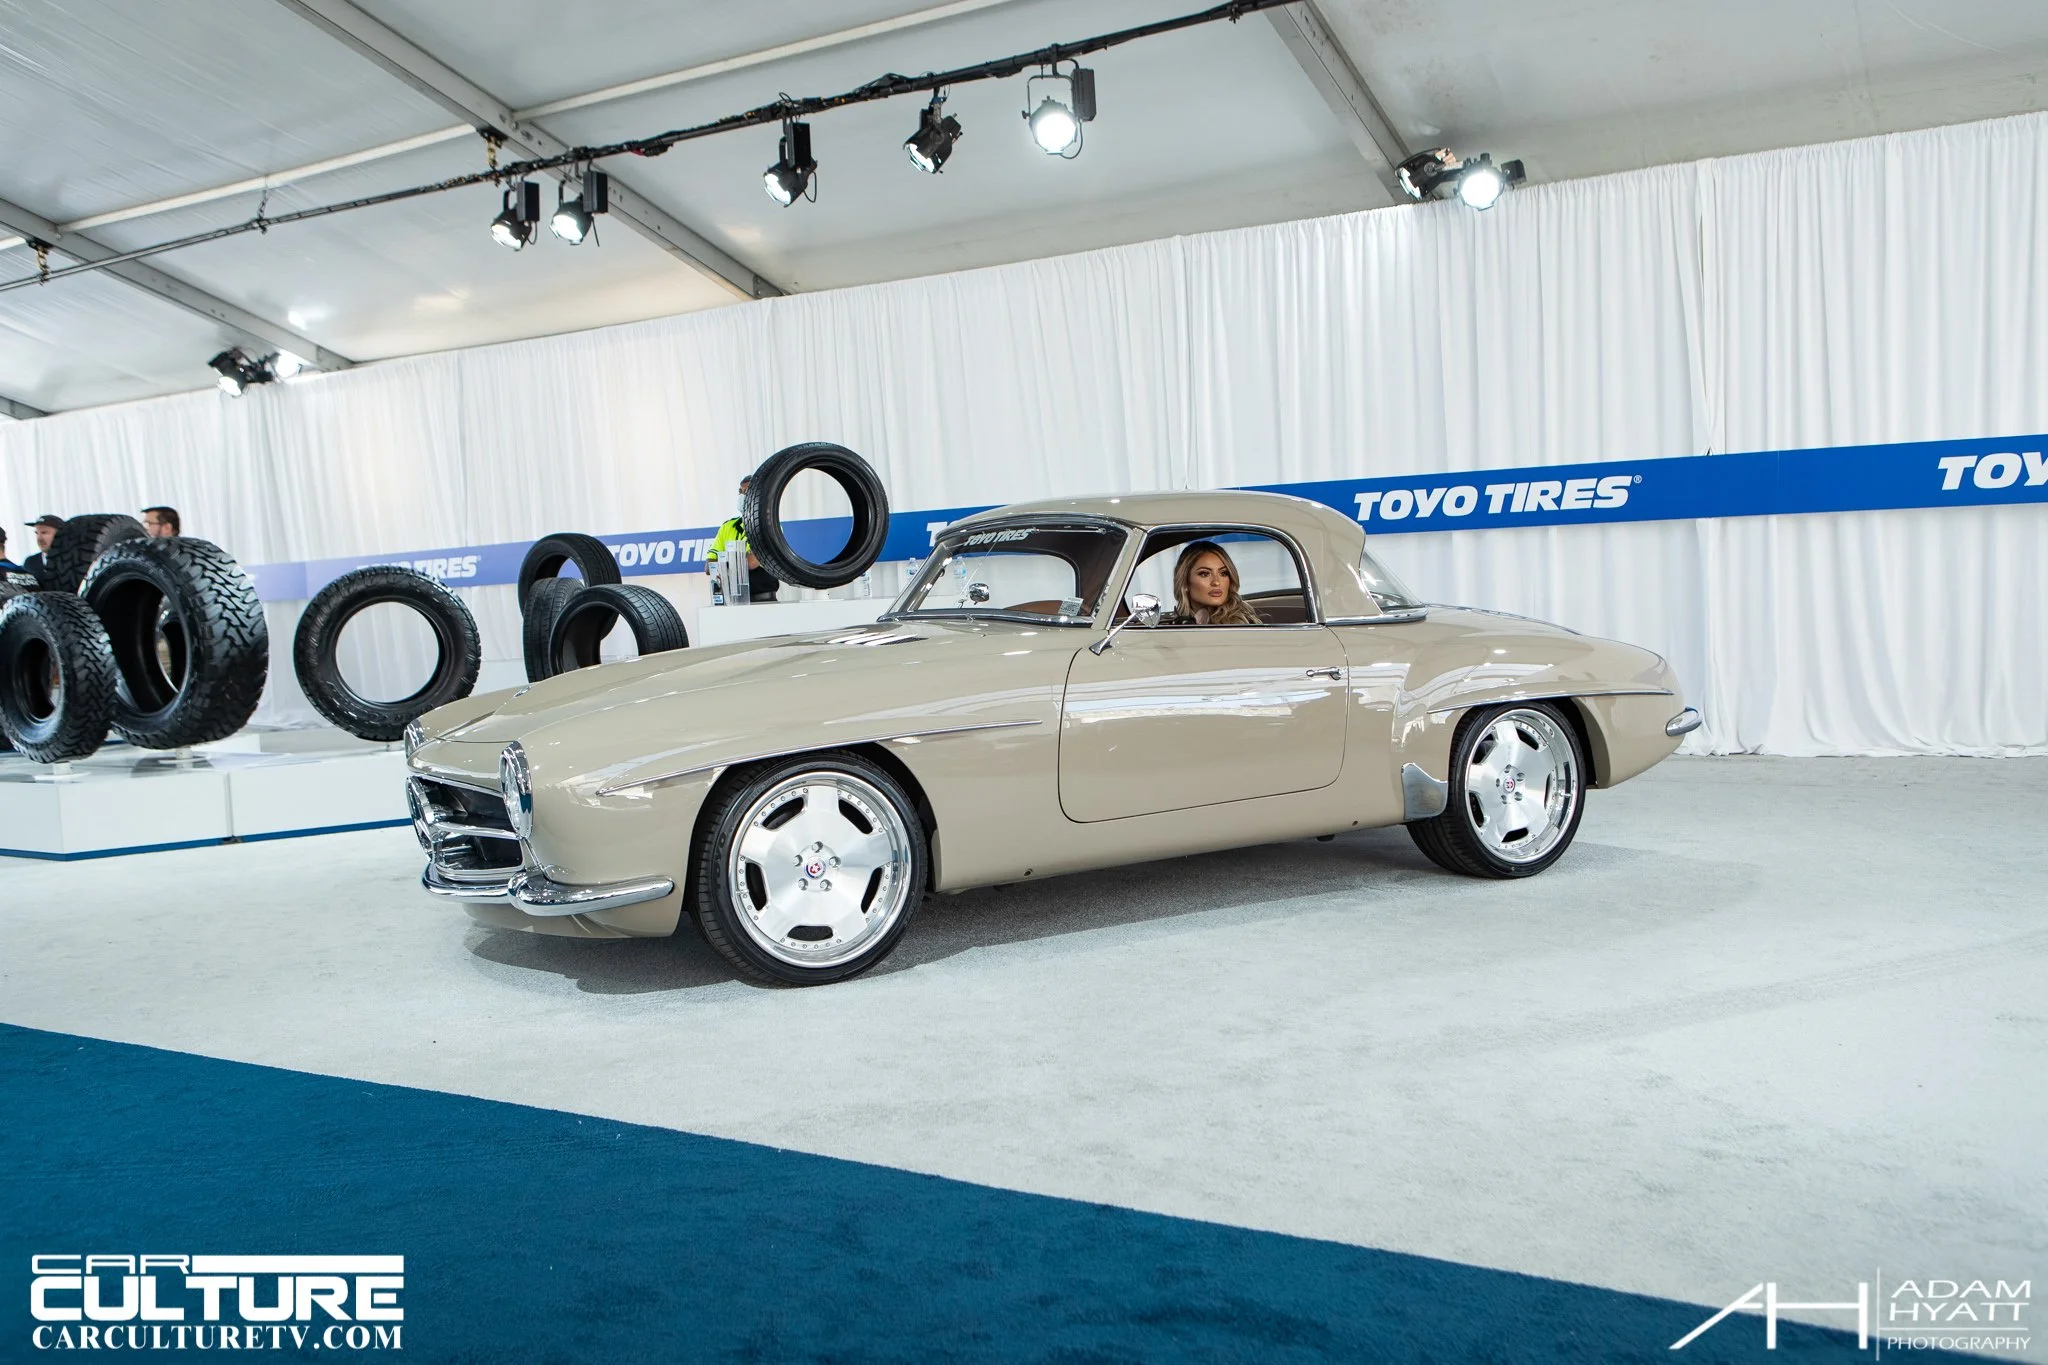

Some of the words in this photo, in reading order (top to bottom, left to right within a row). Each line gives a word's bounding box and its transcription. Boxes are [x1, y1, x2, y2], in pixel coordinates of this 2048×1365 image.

[1353, 485, 1478, 521] TOYO
[963, 532, 997, 546] TOYO
[993, 529, 1034, 542] TIRES
